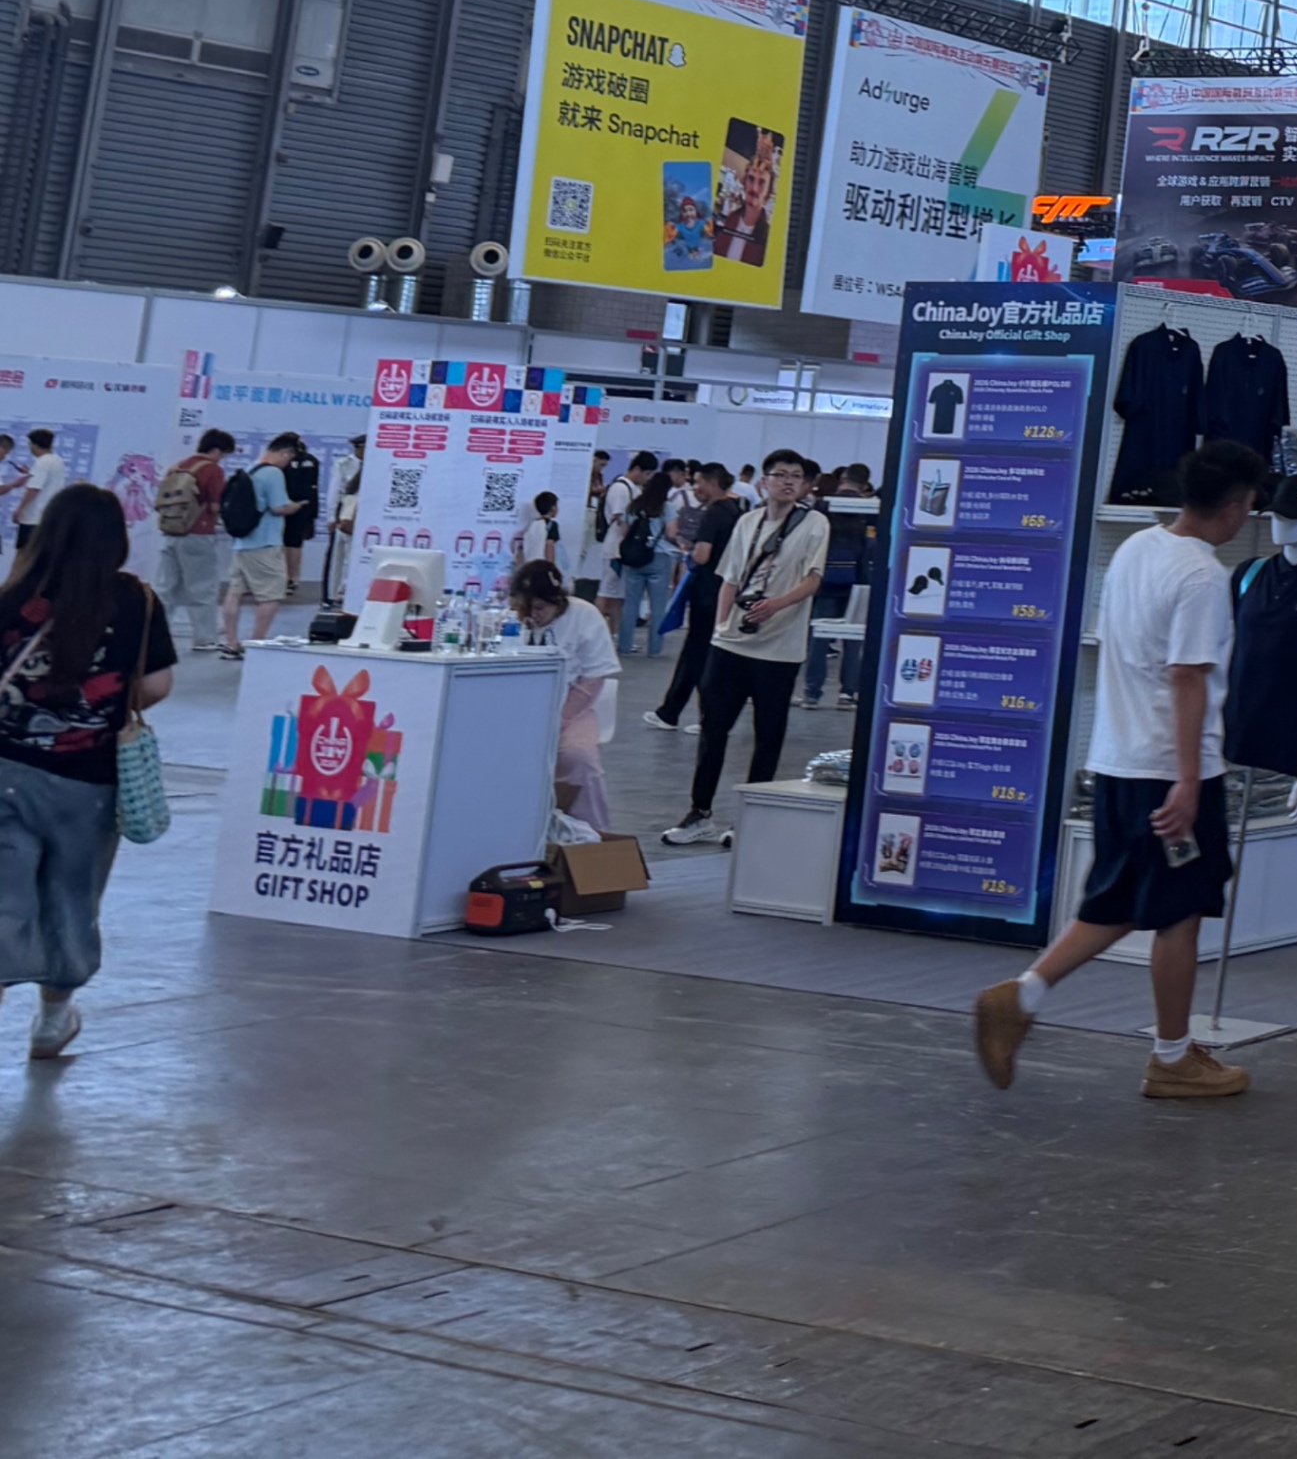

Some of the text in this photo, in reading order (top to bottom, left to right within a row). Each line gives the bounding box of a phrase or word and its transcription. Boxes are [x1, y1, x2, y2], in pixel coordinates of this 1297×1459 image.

[566, 16, 669, 66] SNAPCHAT
[561, 62, 650, 105] 游戏破圈
[557, 99, 700, 149] 就来 Snapchat
[1191, 126, 1280, 151] RZR
[1157, 175, 1197, 188] 全球游戏
[1271, 196, 1294, 206] CTV
[938, 329, 1071, 343] ChinaJoy Official Gift Shop
[255, 830, 381, 878] 官方礼品店
[255, 873, 369, 908] GIFT SHOP
